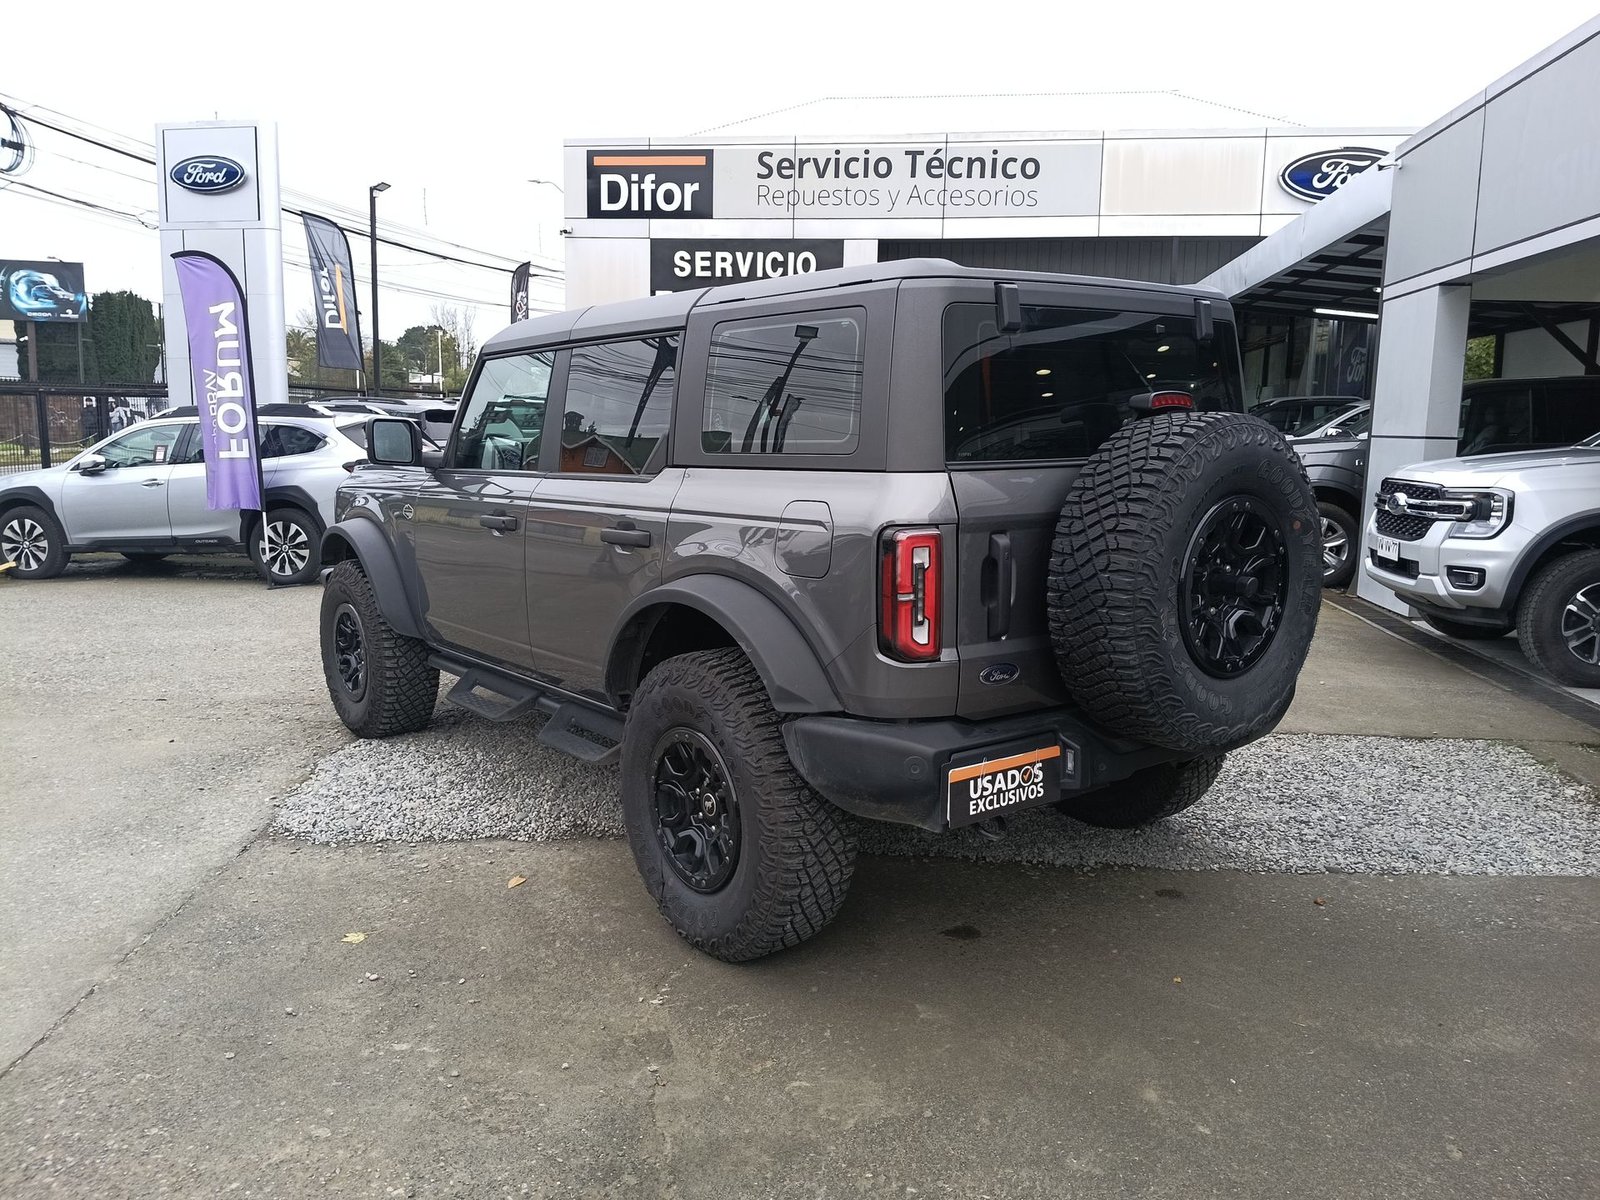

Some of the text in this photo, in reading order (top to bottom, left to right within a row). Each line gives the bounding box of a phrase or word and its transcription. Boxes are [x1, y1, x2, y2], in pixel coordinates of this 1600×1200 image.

[183, 162, 228, 184] Ford
[756, 148, 1041, 180] Servicio Técnico
[1312, 158, 1372, 189] Fo
[600, 173, 700, 212] Difor
[757, 184, 1039, 213] Repuestos y Accesorios
[673, 250, 818, 279] SERVICIO
[989, 670, 1011, 682] Ford
[969, 762, 1044, 799] USADOS
[969, 783, 1044, 816] EXCLUSIVOS
